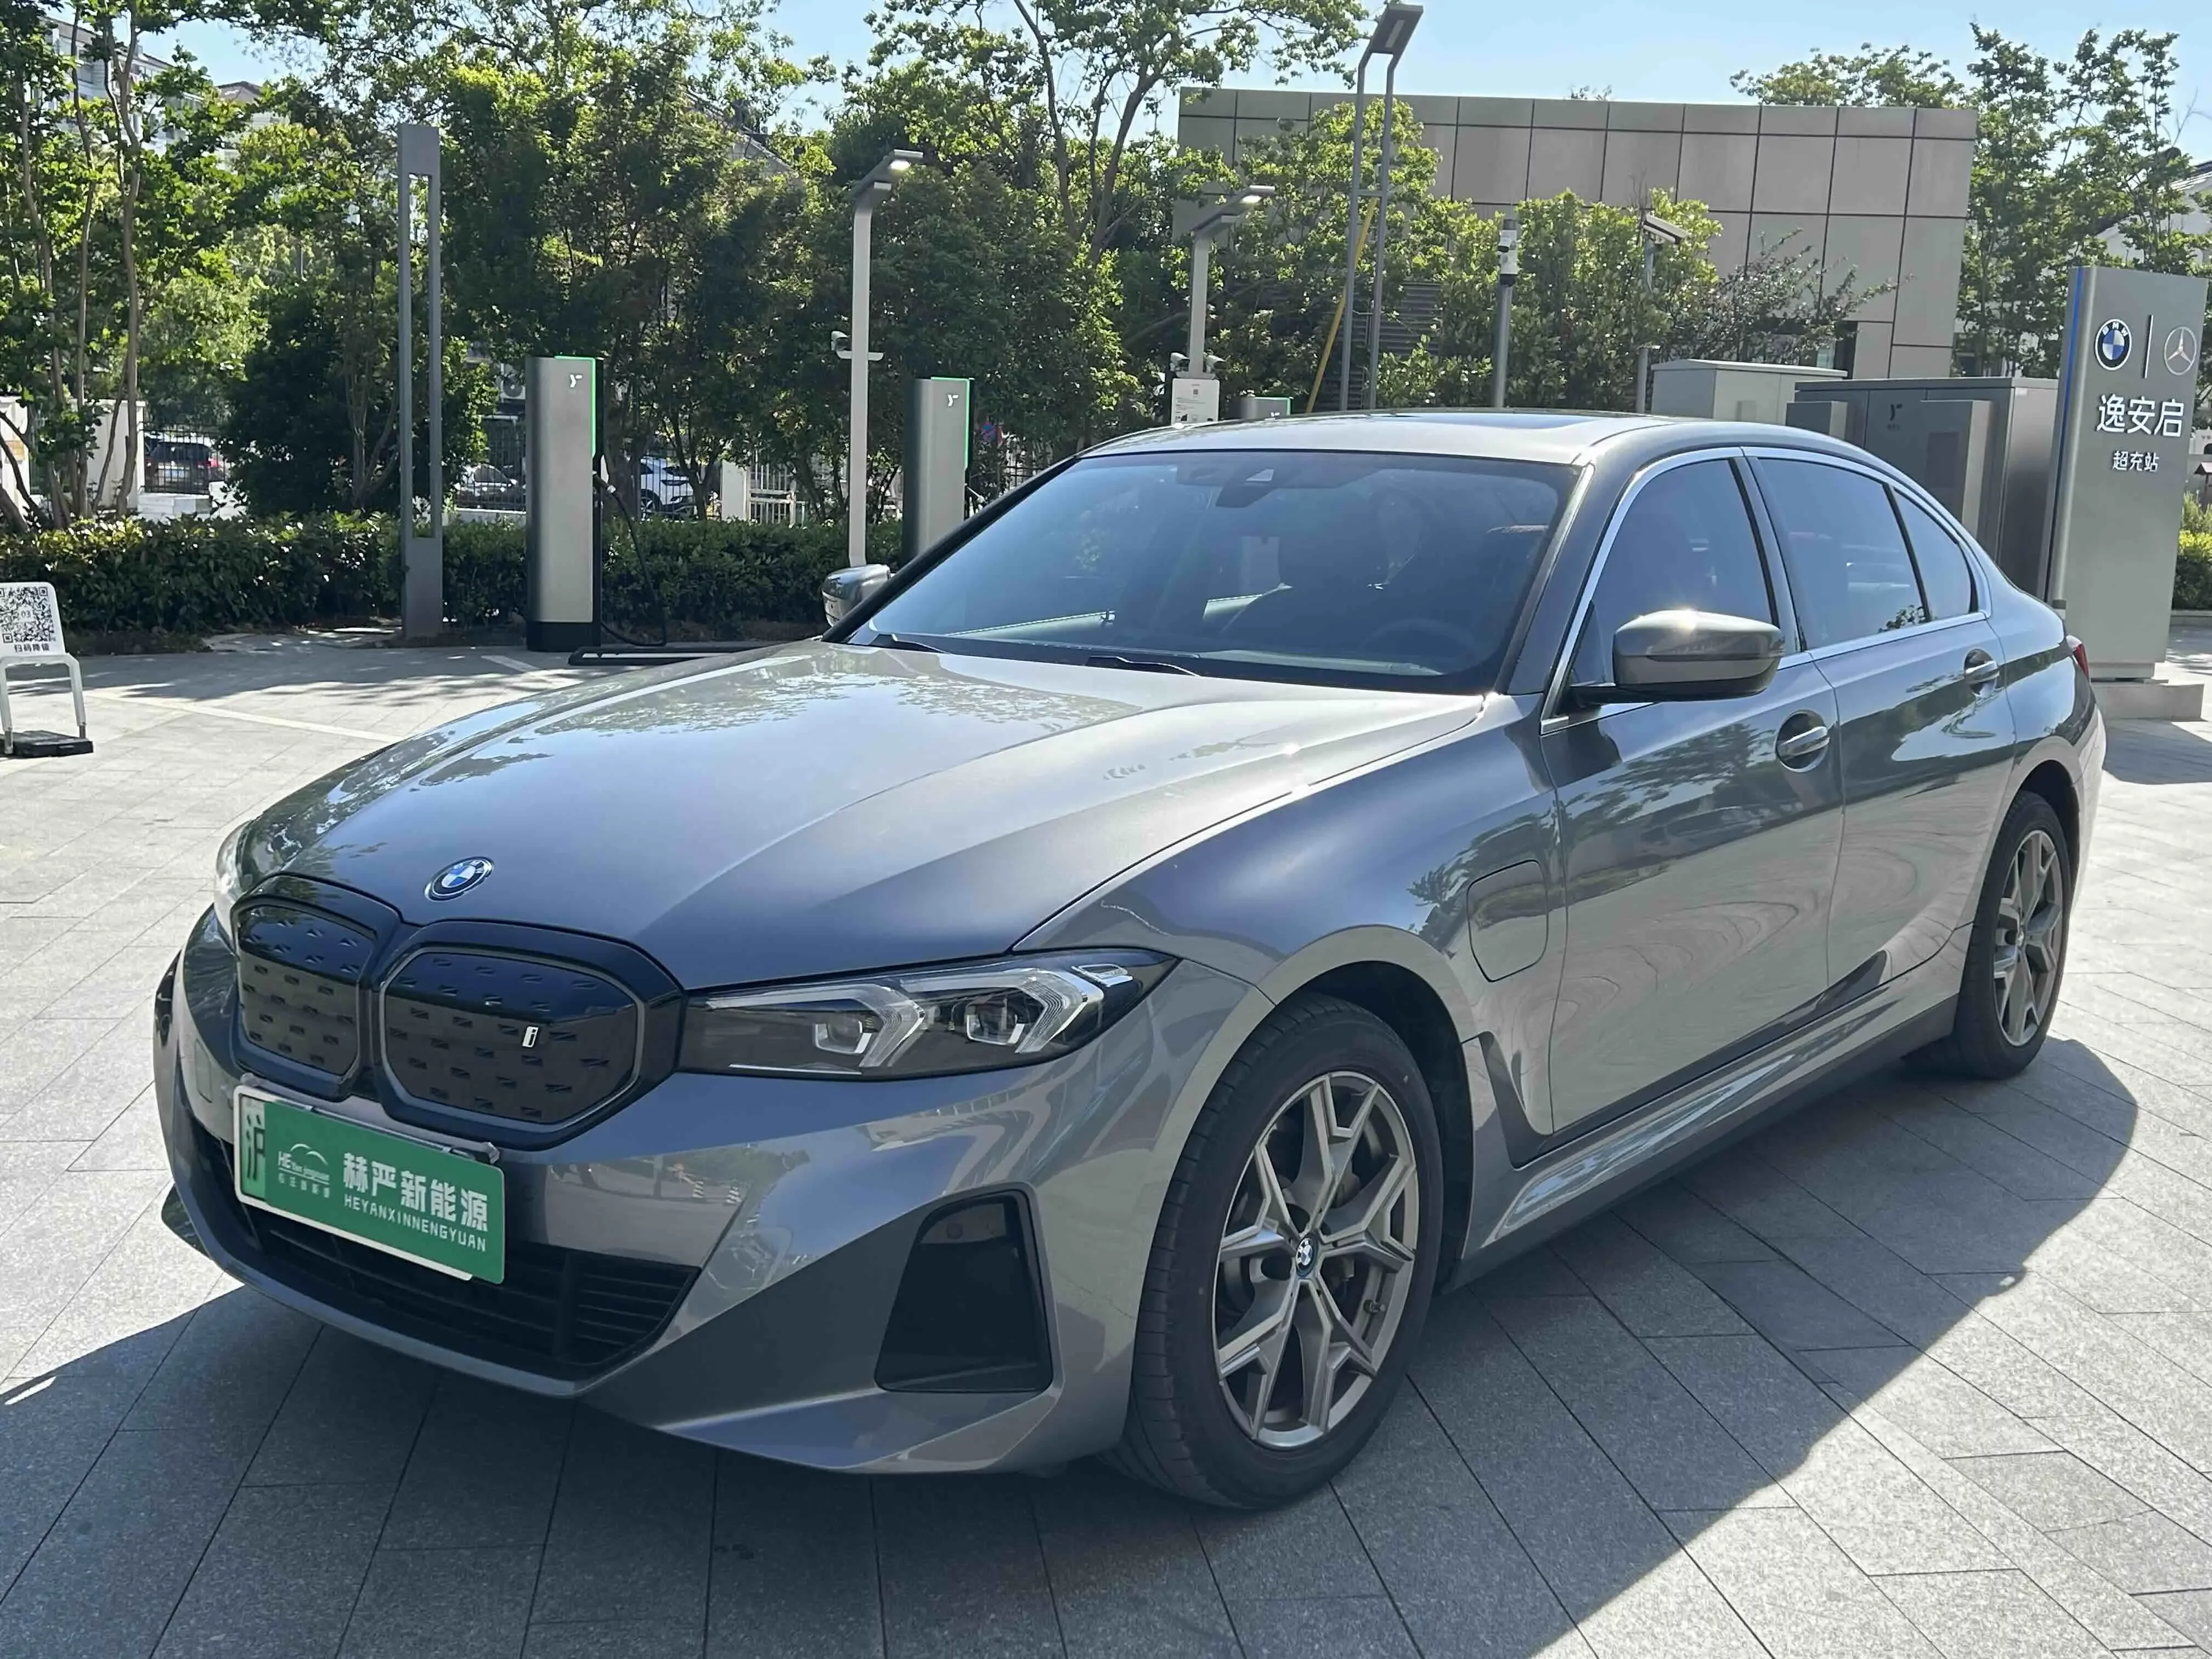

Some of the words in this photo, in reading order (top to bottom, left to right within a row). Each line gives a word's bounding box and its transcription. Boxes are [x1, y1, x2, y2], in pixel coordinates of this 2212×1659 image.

[2102, 322, 2129, 337] BMW
[2097, 393, 2184, 437] 逸安启
[2112, 450, 2159, 472] 超充站
[343, 1152, 488, 1232] 赫严新能源
[344, 1193, 487, 1251] HEYANXINNENGYUAN
